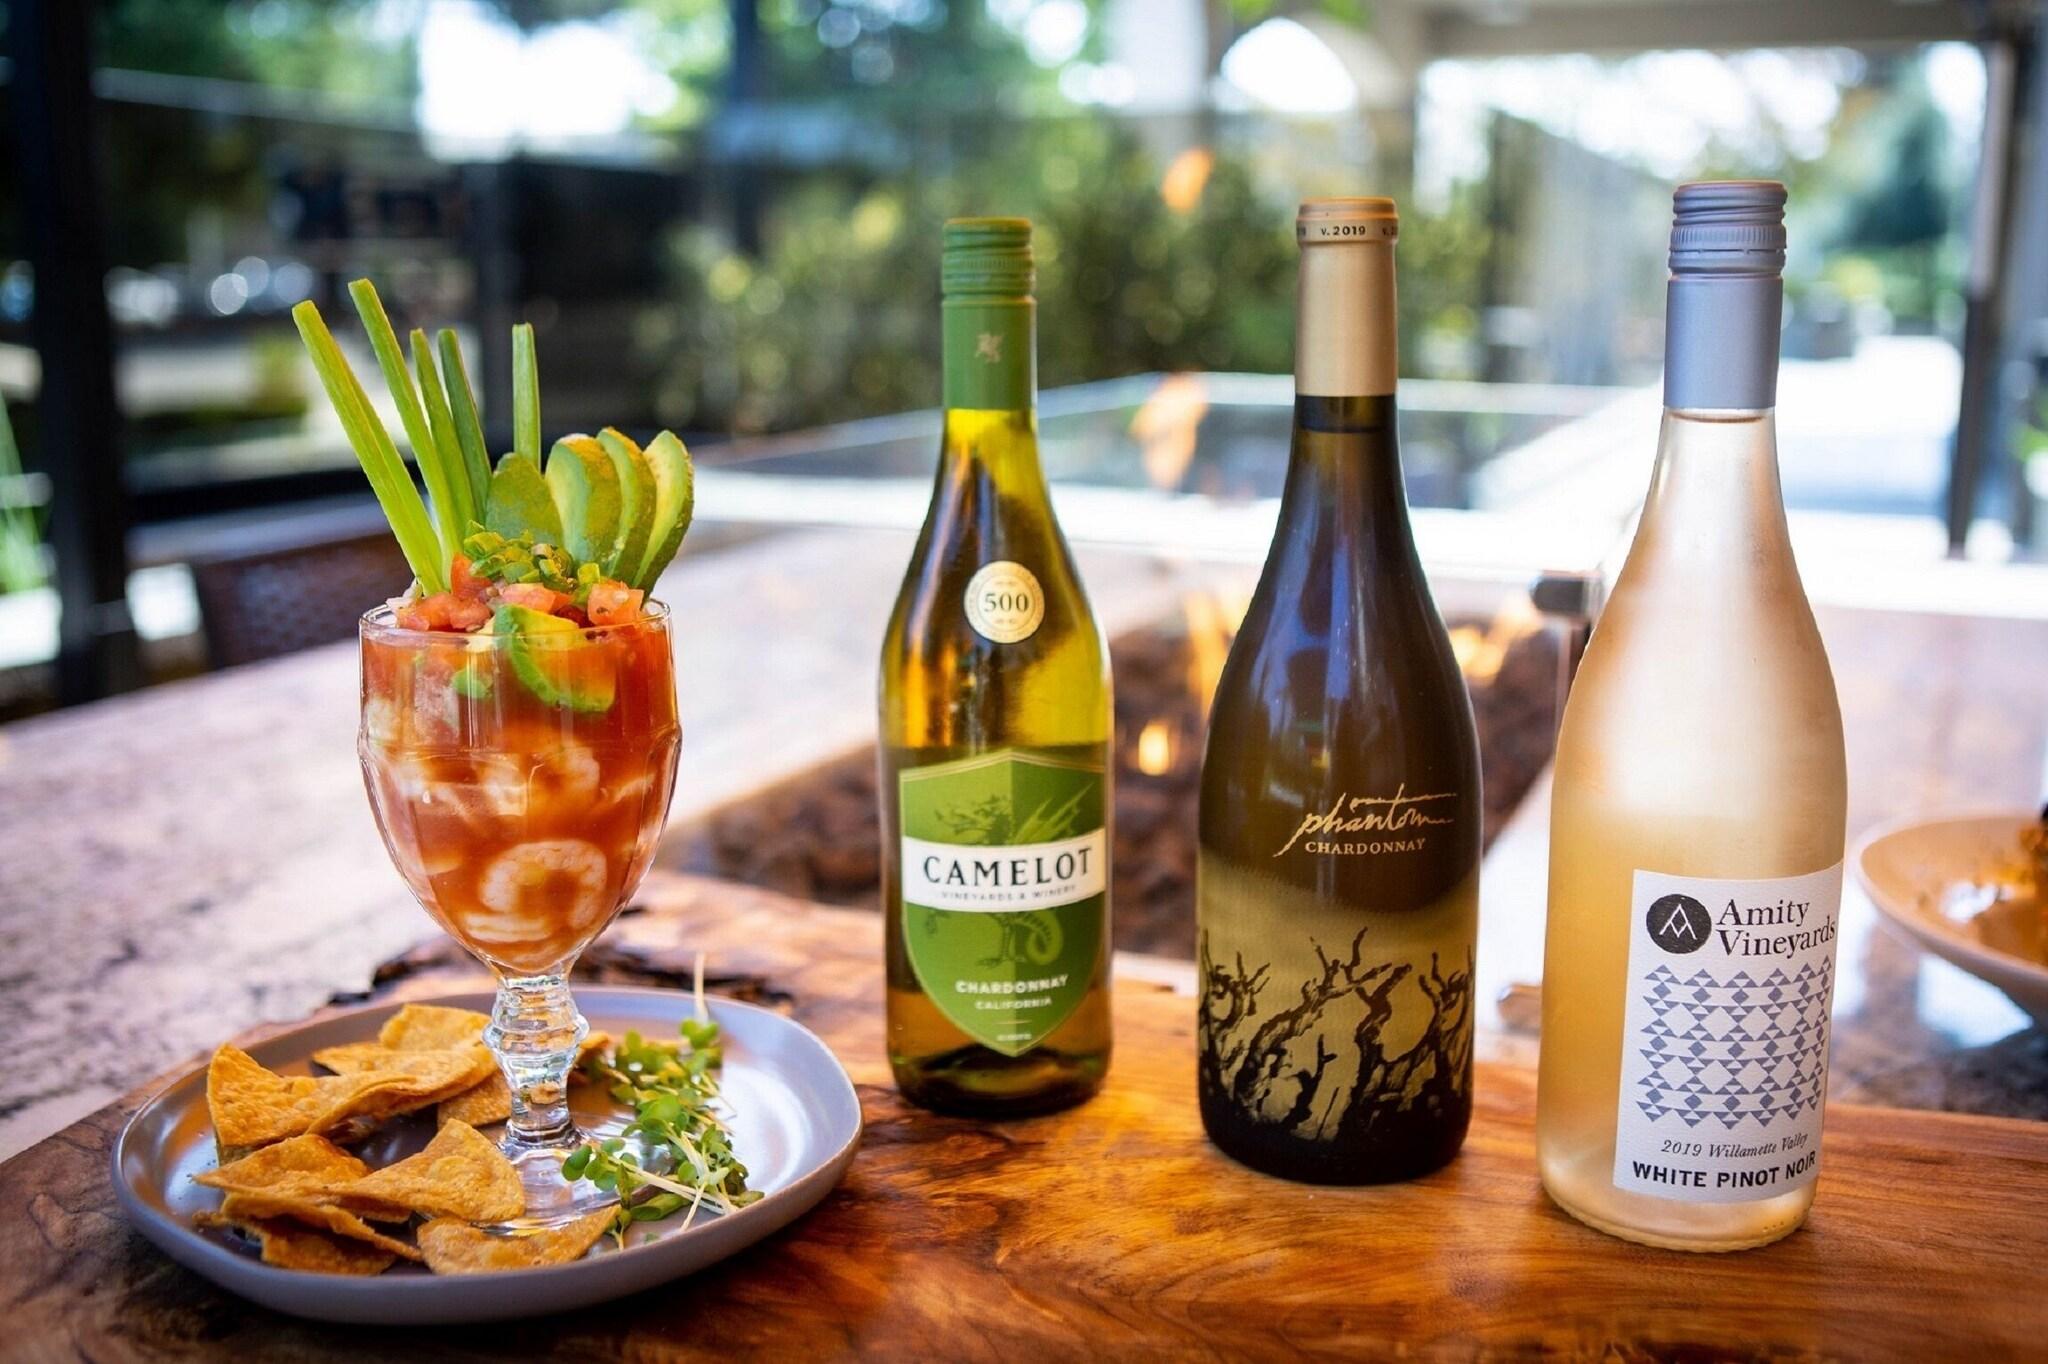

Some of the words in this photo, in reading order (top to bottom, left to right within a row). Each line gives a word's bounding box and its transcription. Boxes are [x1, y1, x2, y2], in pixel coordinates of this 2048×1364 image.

[1333, 225, 1366, 236] 2019
[983, 592, 1029, 613] 500
[1272, 782, 1458, 858] phantom
[1304, 837, 1426, 855] CHARDONNAY
[923, 846, 1092, 887] CAMELOT
[1715, 898, 1810, 927] Amity
[1715, 914, 1836, 959] Vineyards
[955, 973, 1069, 994] CHARDONNAY
[975, 995, 1052, 1010] CALIFORNIA
[1660, 1139, 1703, 1157] 2019
[1708, 1142, 1777, 1159] Willamette
[1782, 1131, 1809, 1150] Valley
[1632, 1160, 1707, 1187] WHITE
[1716, 1166, 1780, 1188] PINOT
[1785, 1149, 1816, 1180] NOIR
